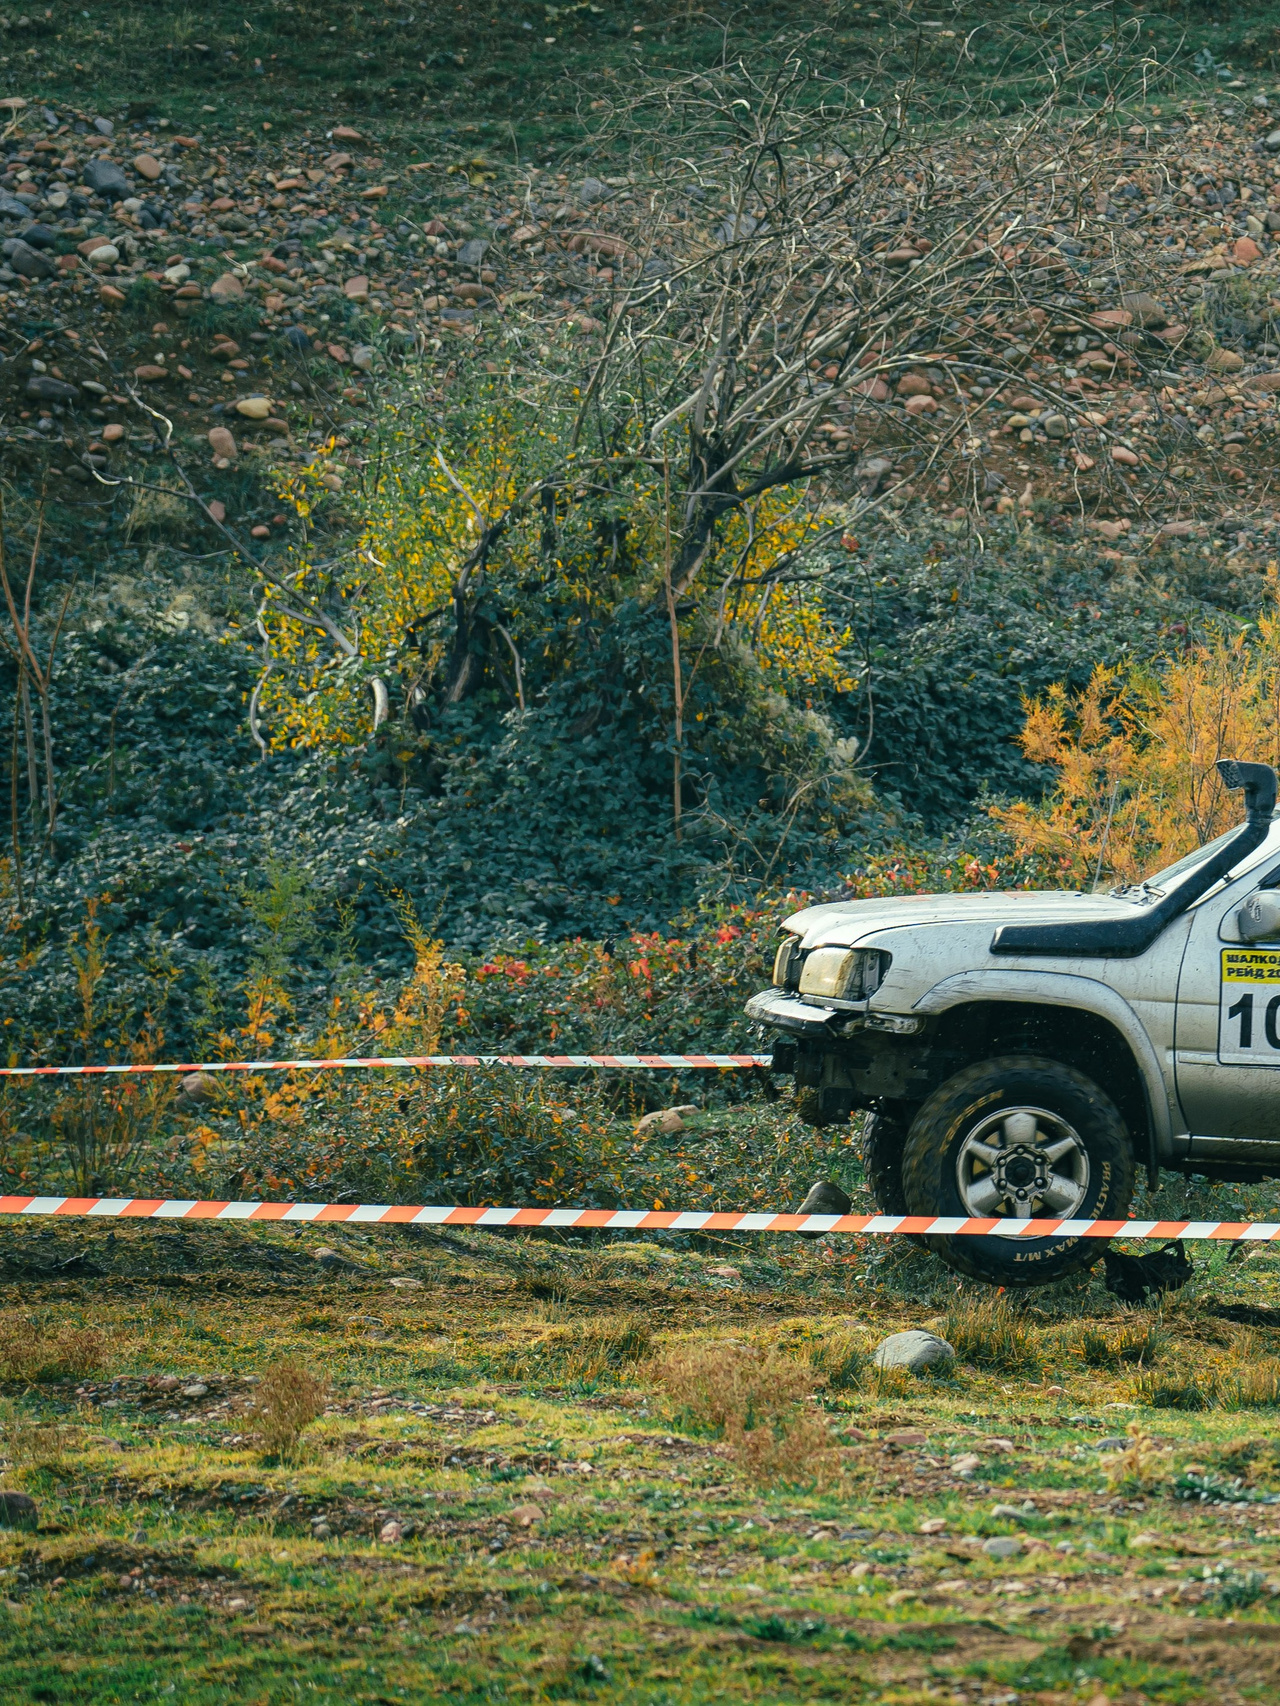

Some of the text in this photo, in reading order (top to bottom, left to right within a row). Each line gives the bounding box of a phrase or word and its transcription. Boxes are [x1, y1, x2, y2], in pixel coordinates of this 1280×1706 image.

[1227, 965, 1265, 979] РЕЙД
[1089, 1161, 1111, 1220] PRACTIC
[1014, 1251, 1041, 1262] M/T
